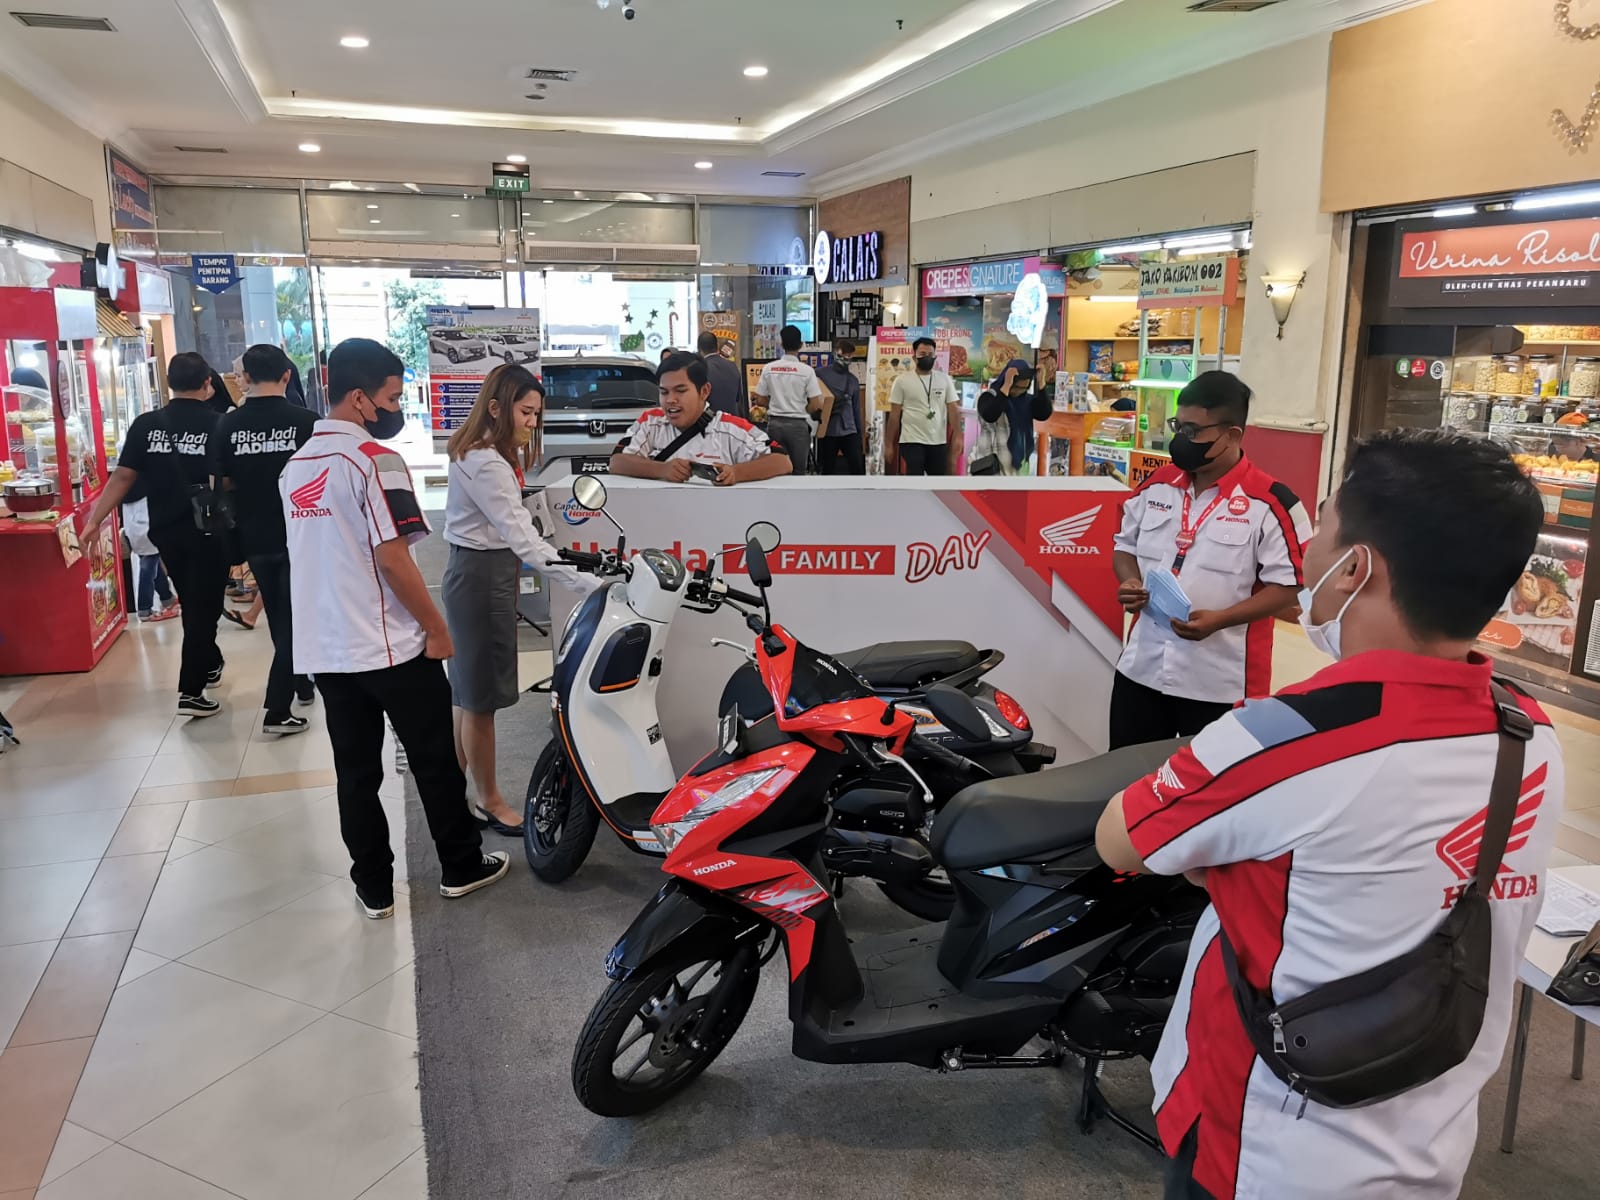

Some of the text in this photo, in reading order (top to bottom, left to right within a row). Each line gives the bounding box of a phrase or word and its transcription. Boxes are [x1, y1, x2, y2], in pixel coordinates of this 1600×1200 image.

[498, 178, 525, 189] EXIT
[199, 258, 227, 266] TEMPAT
[1410, 240, 1511, 271] Verina
[1200, 262, 1222, 280] 002
[201, 276, 230, 284] BARANG
[1445, 281, 1493, 290] OLEH-OLEH
[1526, 279, 1587, 287] PEKANBARU
[269, 427, 297, 441] Jadi
[147, 442, 205, 455] JADBISA
[234, 440, 297, 455] JADIBISA
[291, 508, 332, 519] HONDA
[905, 530, 992, 583] DAY
[1039, 546, 1100, 554] HONDA
[781, 551, 881, 570] FAMILY
[693, 859, 737, 876] HONDA
[1440, 874, 1538, 910] HNDA
